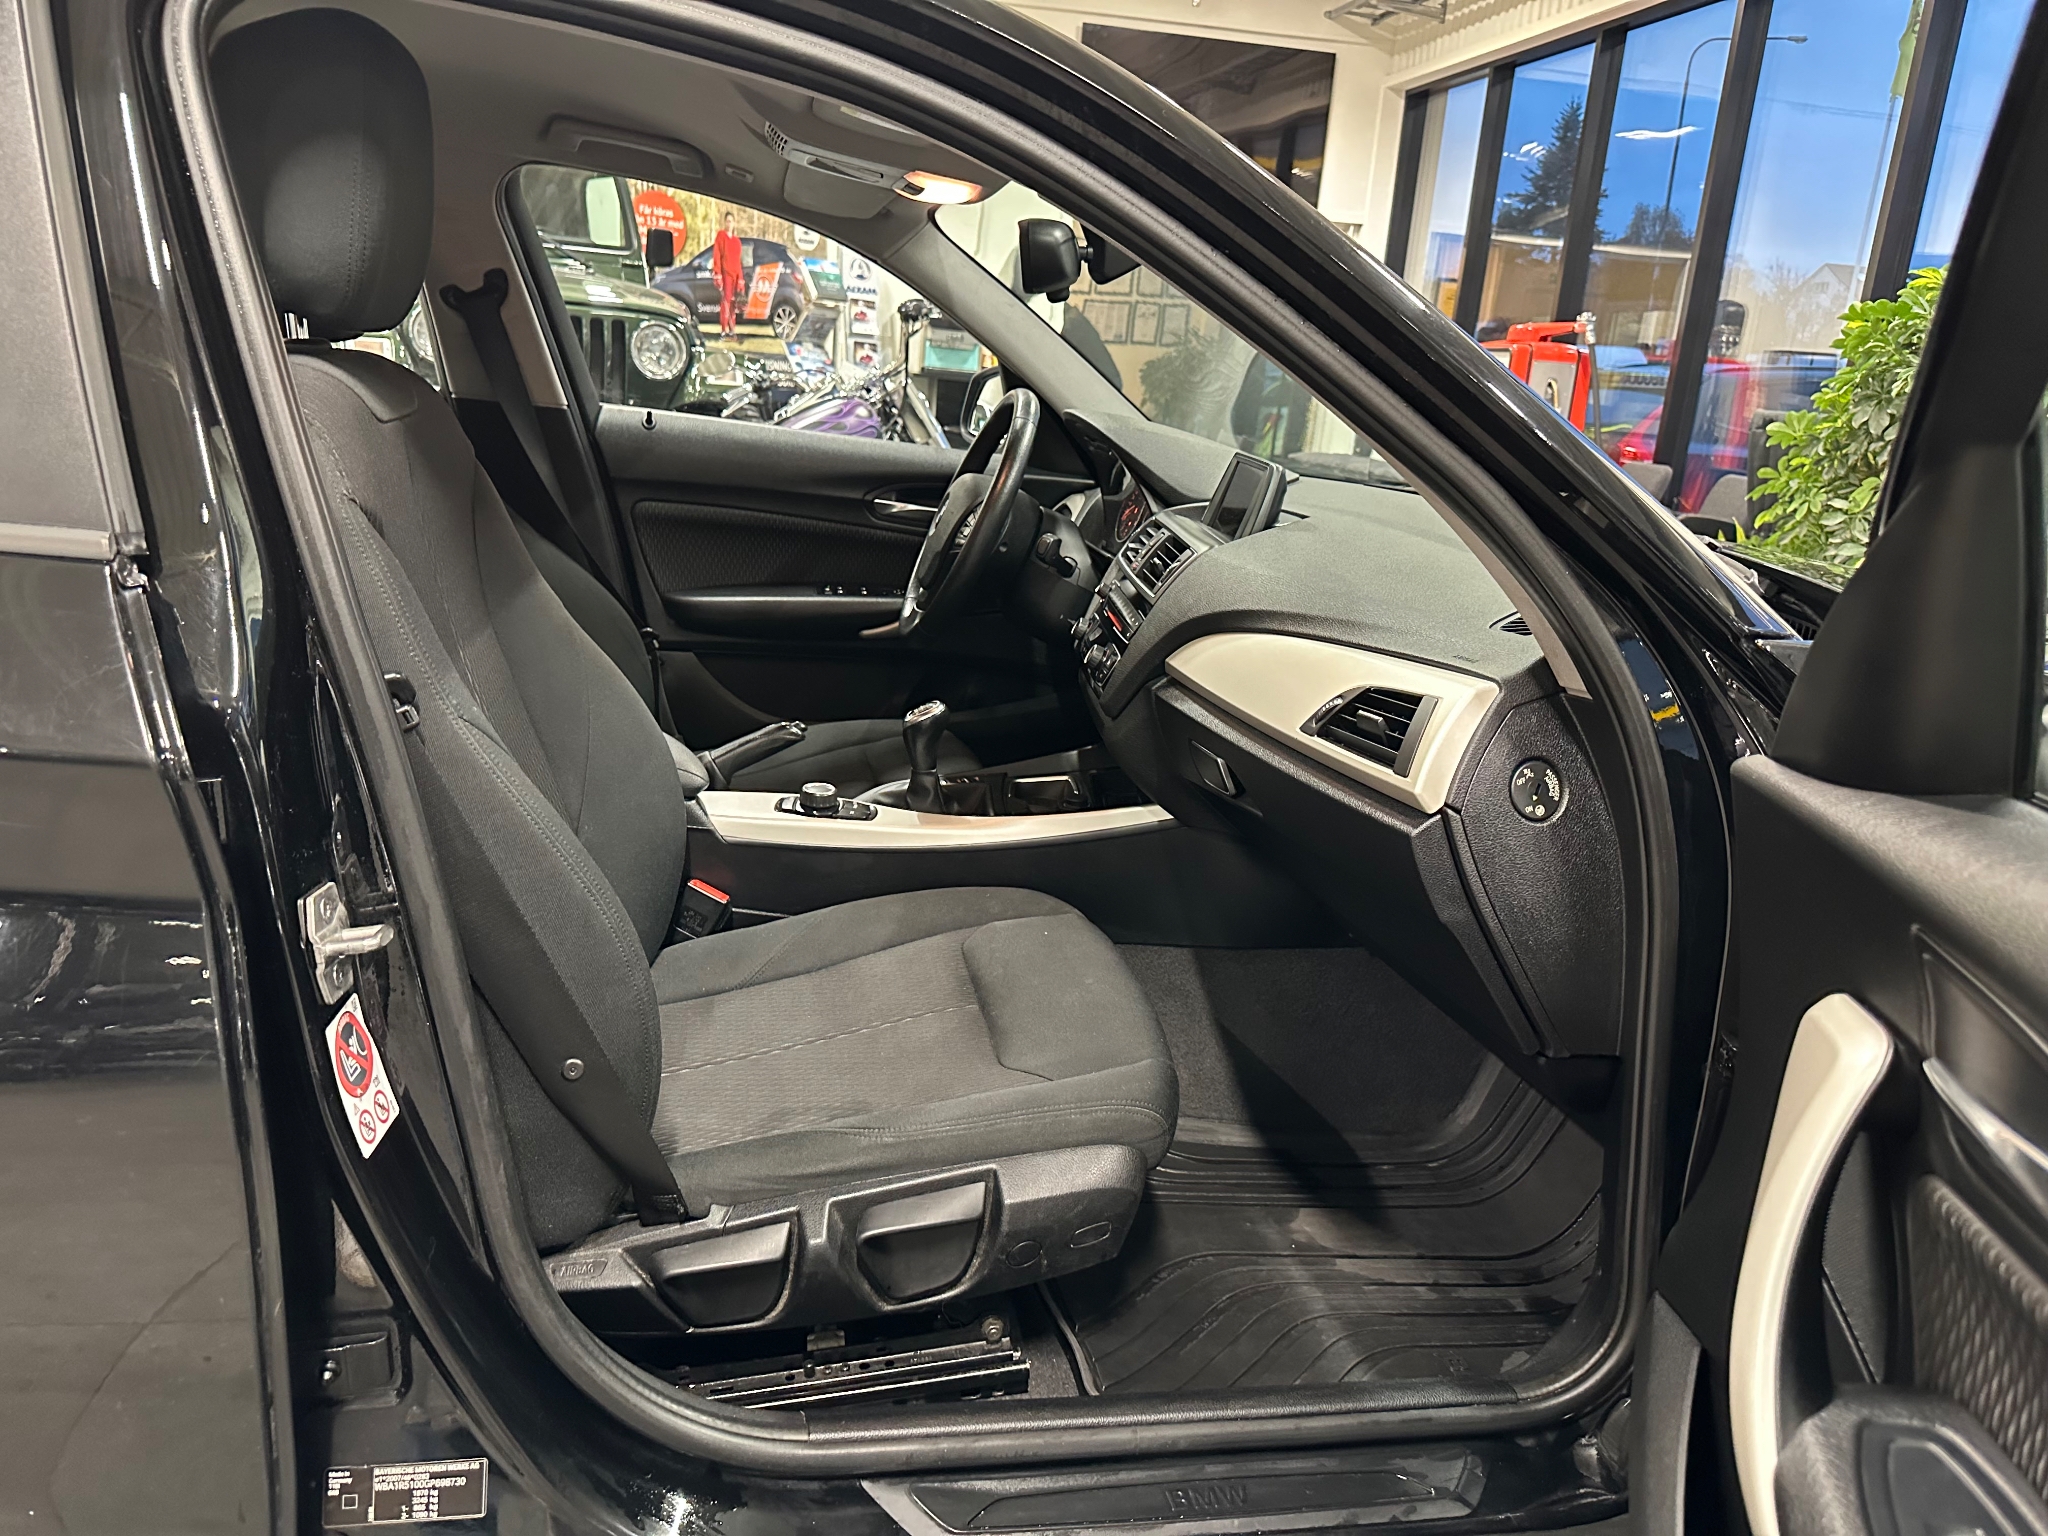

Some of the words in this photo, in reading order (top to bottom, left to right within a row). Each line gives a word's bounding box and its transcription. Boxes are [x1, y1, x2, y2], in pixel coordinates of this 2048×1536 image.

[1517, 777, 1526, 786] OFF
[1525, 805, 1533, 813] ON
[1165, 1484, 1247, 1512] BMW
